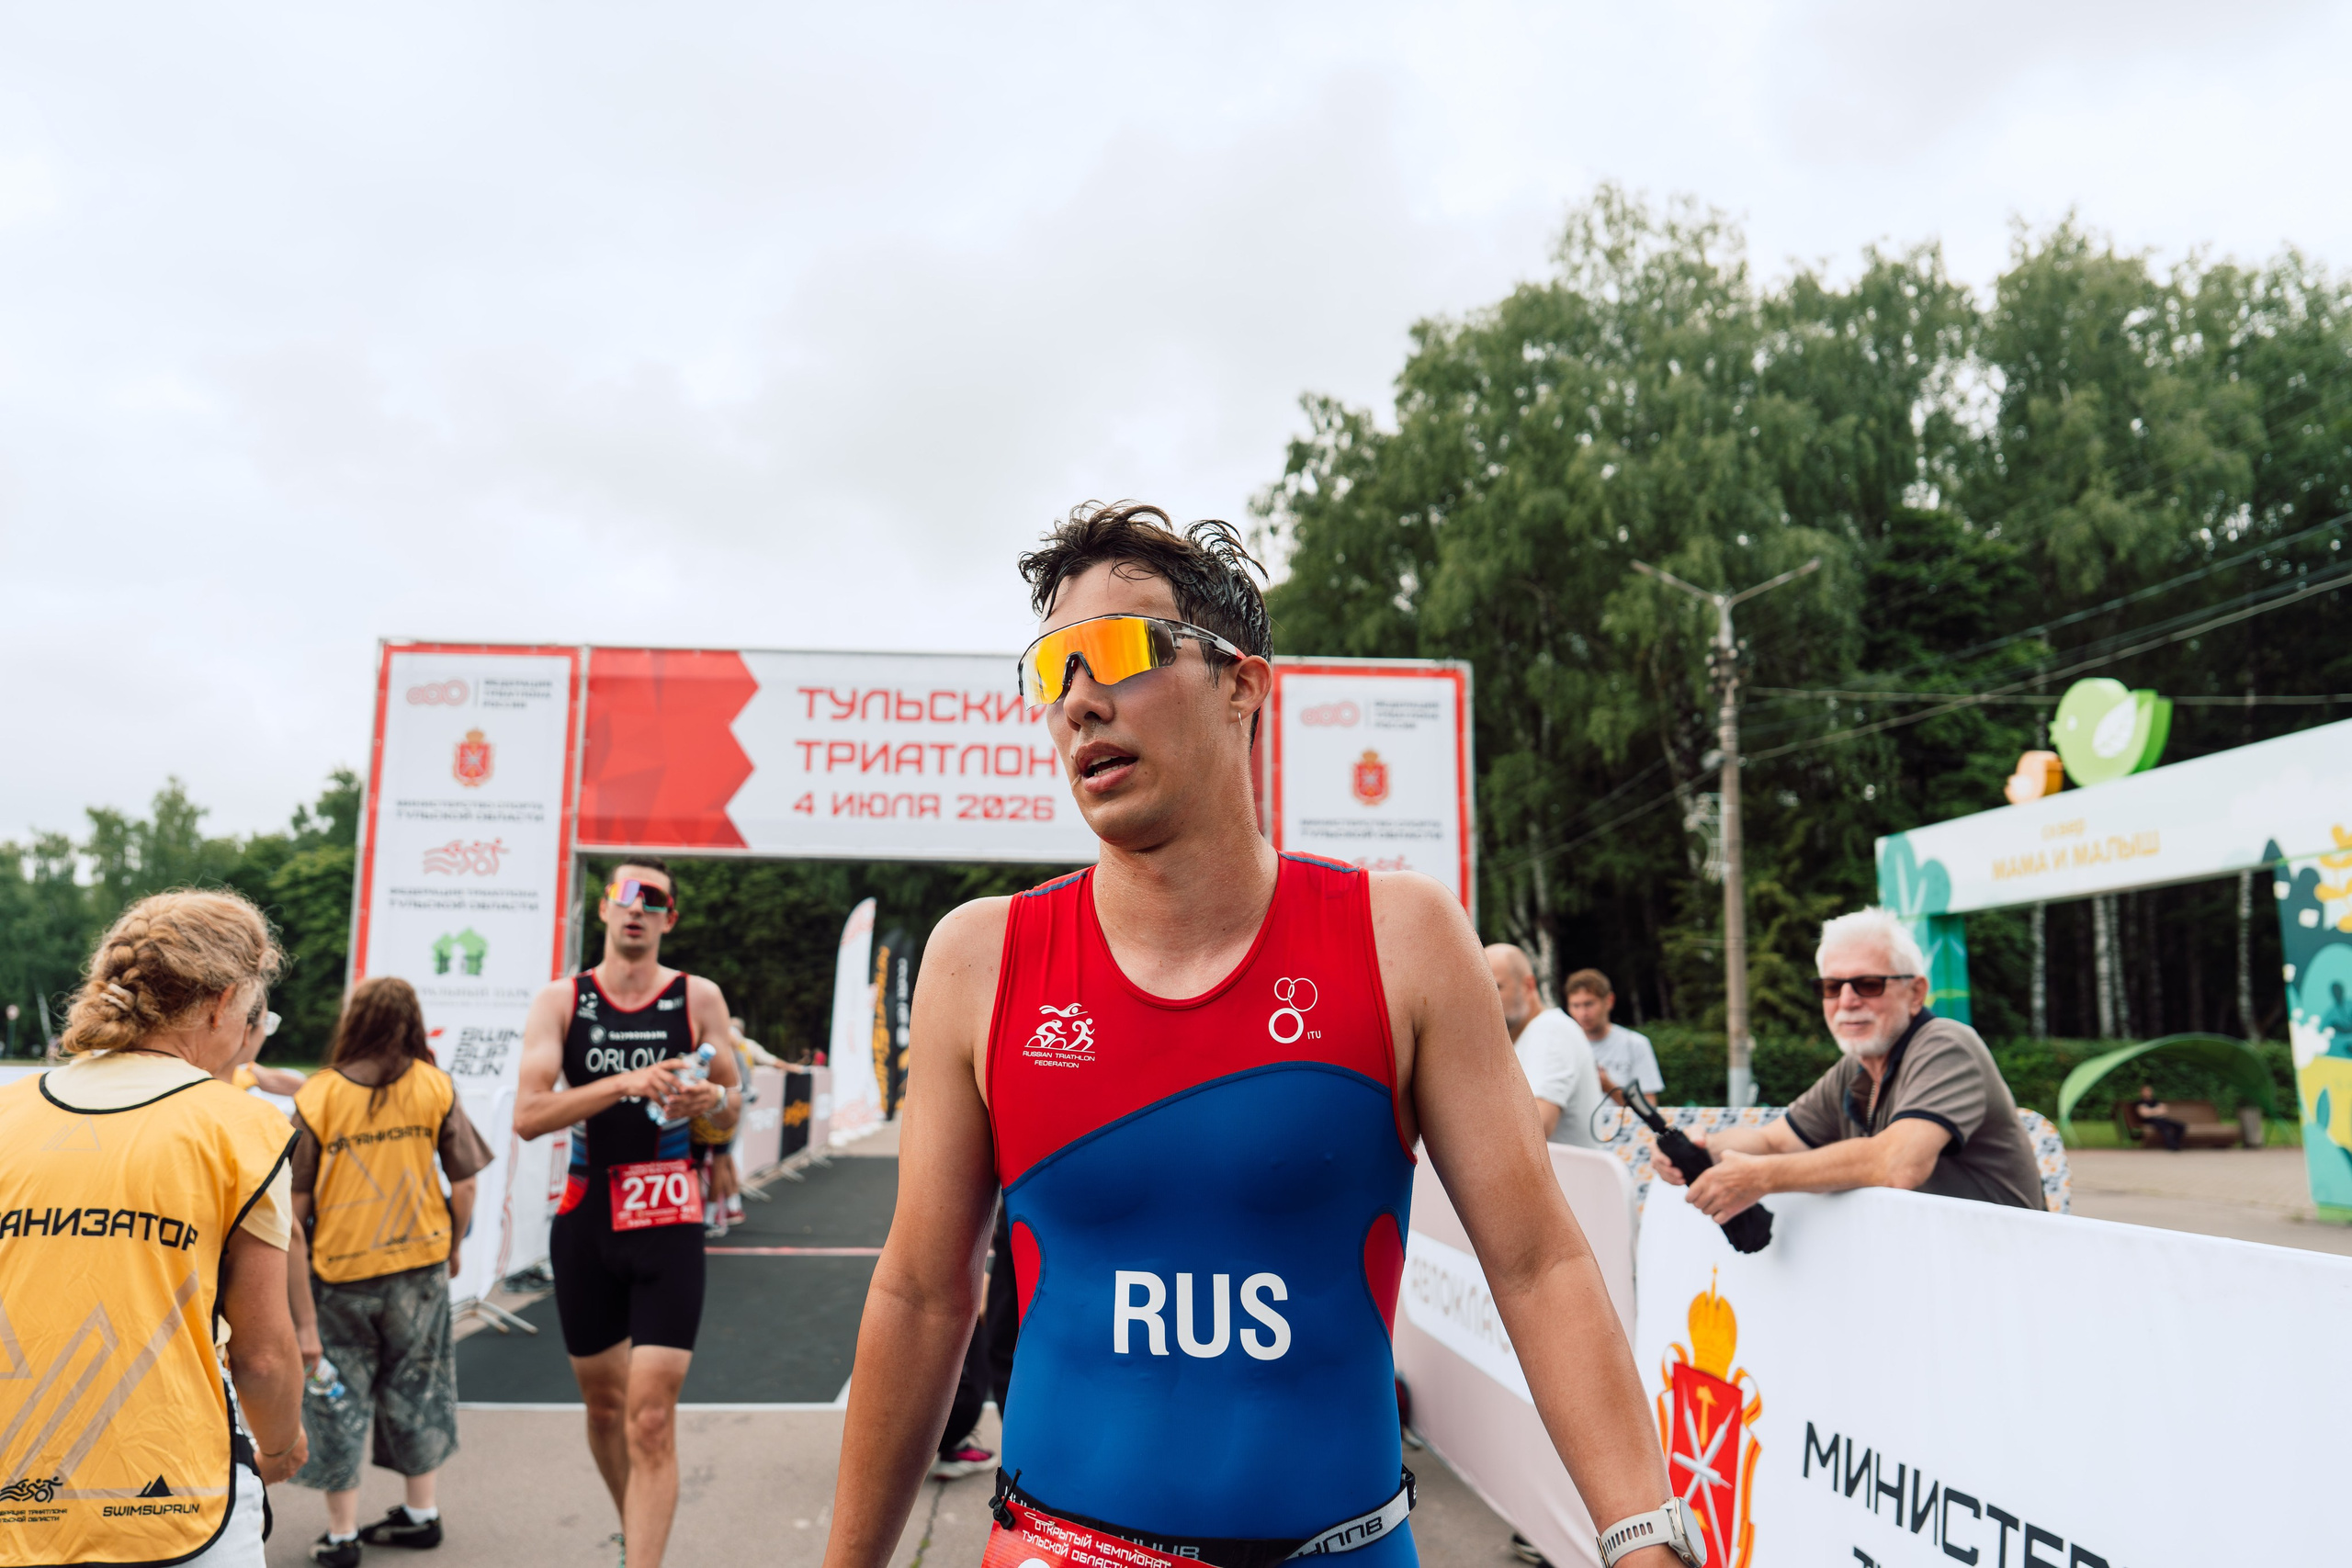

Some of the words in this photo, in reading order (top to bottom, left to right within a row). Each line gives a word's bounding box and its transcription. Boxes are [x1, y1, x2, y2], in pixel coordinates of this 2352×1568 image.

[796, 740, 1056, 777] ТРИАТЛОН
[793, 791, 815, 816] 4
[831, 793, 940, 818] ИЮЛЯ
[956, 794, 1055, 820] 2026
[1992, 849, 2049, 882] МАМА
[2052, 844, 2069, 872] И
[2071, 829, 2161, 868] МАЛЫШ
[1306, 1030, 1321, 1040] ITU
[585, 1047, 667, 1073] ORLOV
[1022, 1050, 1053, 1058] RUSSIAN
[1055, 1053, 1095, 1062] TRIATHLON
[1034, 1059, 1080, 1068] FEDERATION
[621, 1172, 690, 1211] 270
[0, 1208, 198, 1251] АНИЗАТОР
[1113, 1269, 1292, 1361] RUS
[102, 1503, 200, 1517] SWIMSUPRUN
[1022, 1529, 1069, 1556] ТУЛЬСКОЙ
[1035, 1520, 1092, 1550] ОТКРЫТЫЙ
